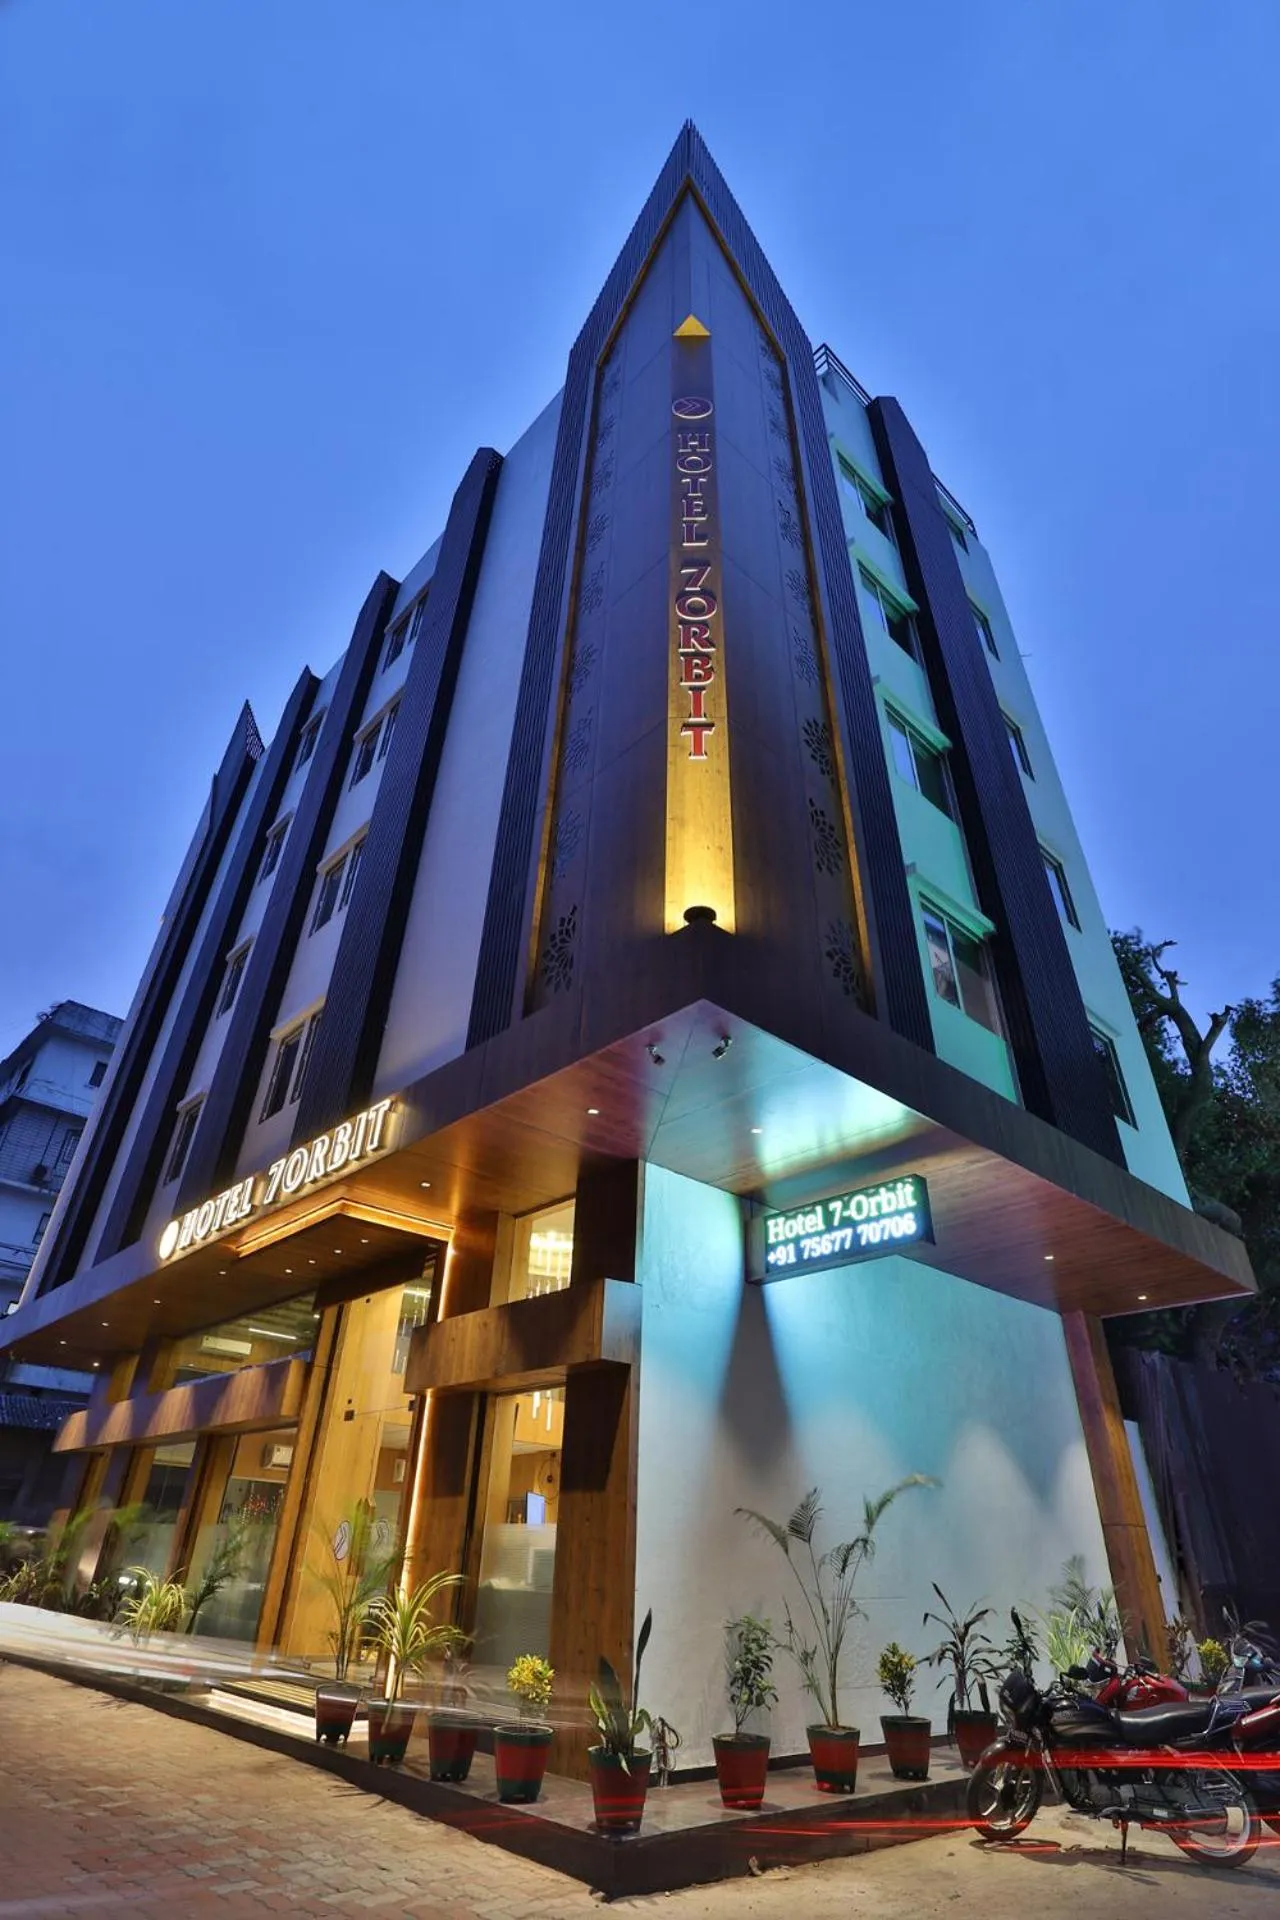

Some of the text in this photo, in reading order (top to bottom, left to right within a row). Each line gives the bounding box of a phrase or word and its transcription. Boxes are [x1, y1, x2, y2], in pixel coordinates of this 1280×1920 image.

[676, 433, 713, 546] HOTEL
[179, 1177, 255, 1249] HOTEL
[766, 1182, 917, 1243] Hotel 7-Orbit
[766, 1213, 917, 1266] +91 75677 70706
